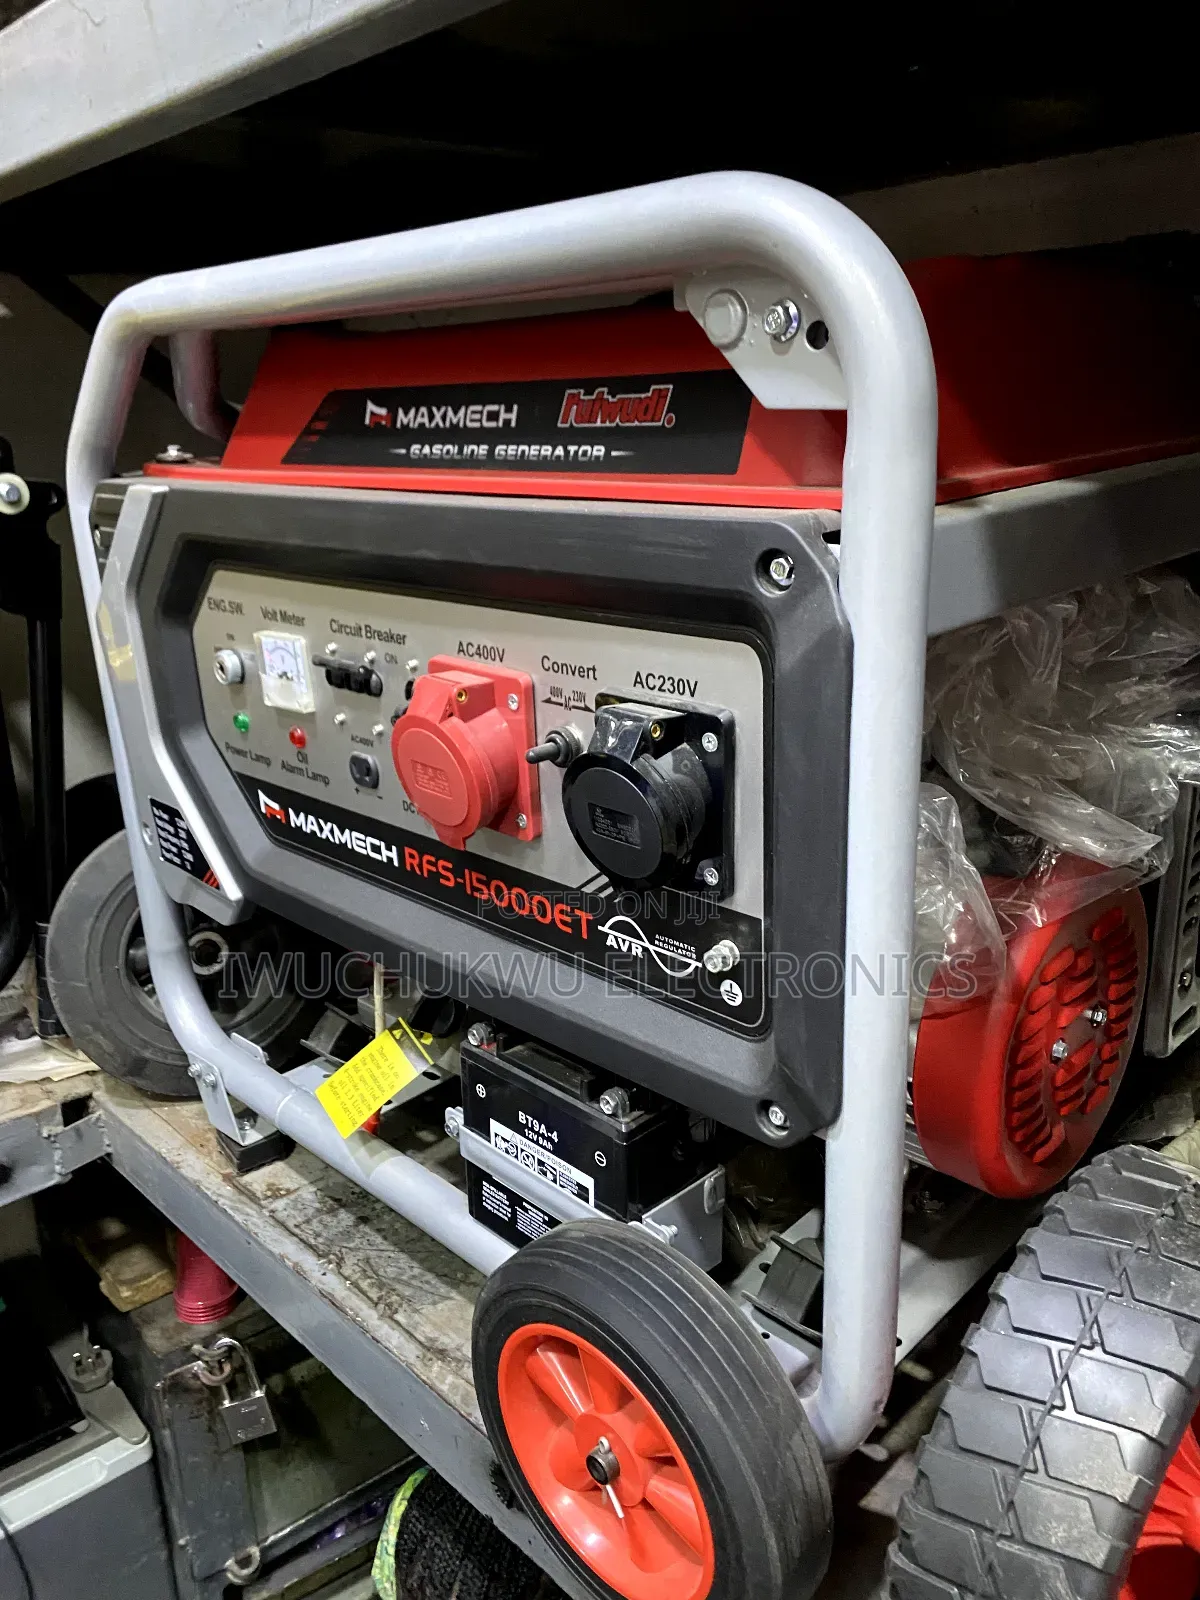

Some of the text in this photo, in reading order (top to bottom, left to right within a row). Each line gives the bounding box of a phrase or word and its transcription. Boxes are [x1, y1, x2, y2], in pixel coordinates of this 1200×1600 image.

[396, 404, 518, 429] MAXMECH
[409, 443, 606, 462] GASOLINE GENERATOR
[260, 606, 306, 627] Volt Meter
[329, 618, 407, 645] Circuit Breaker
[384, 652, 398, 665] ON
[457, 641, 505, 663] AC400V
[541, 655, 598, 681] Convert
[550, 685, 587, 704] 400V 230V
[633, 670, 698, 698] AC230V
[563, 696, 572, 711] AC
[224, 741, 271, 768] Power Lamp
[296, 750, 308, 765] Oil
[281, 760, 330, 788] Alarm Lamp
[287, 807, 399, 867] MAXMECH
[403, 846, 594, 940] RFS-15000ET
[605, 934, 644, 959] AVR
[654, 939, 697, 960] REGULATOR
[655, 933, 696, 953] AUTOMATIC
[518, 1110, 559, 1143] BT9A-4
[524, 1128, 538, 1142] 12V
[519, 1139, 573, 1175] DANGER/POISON
